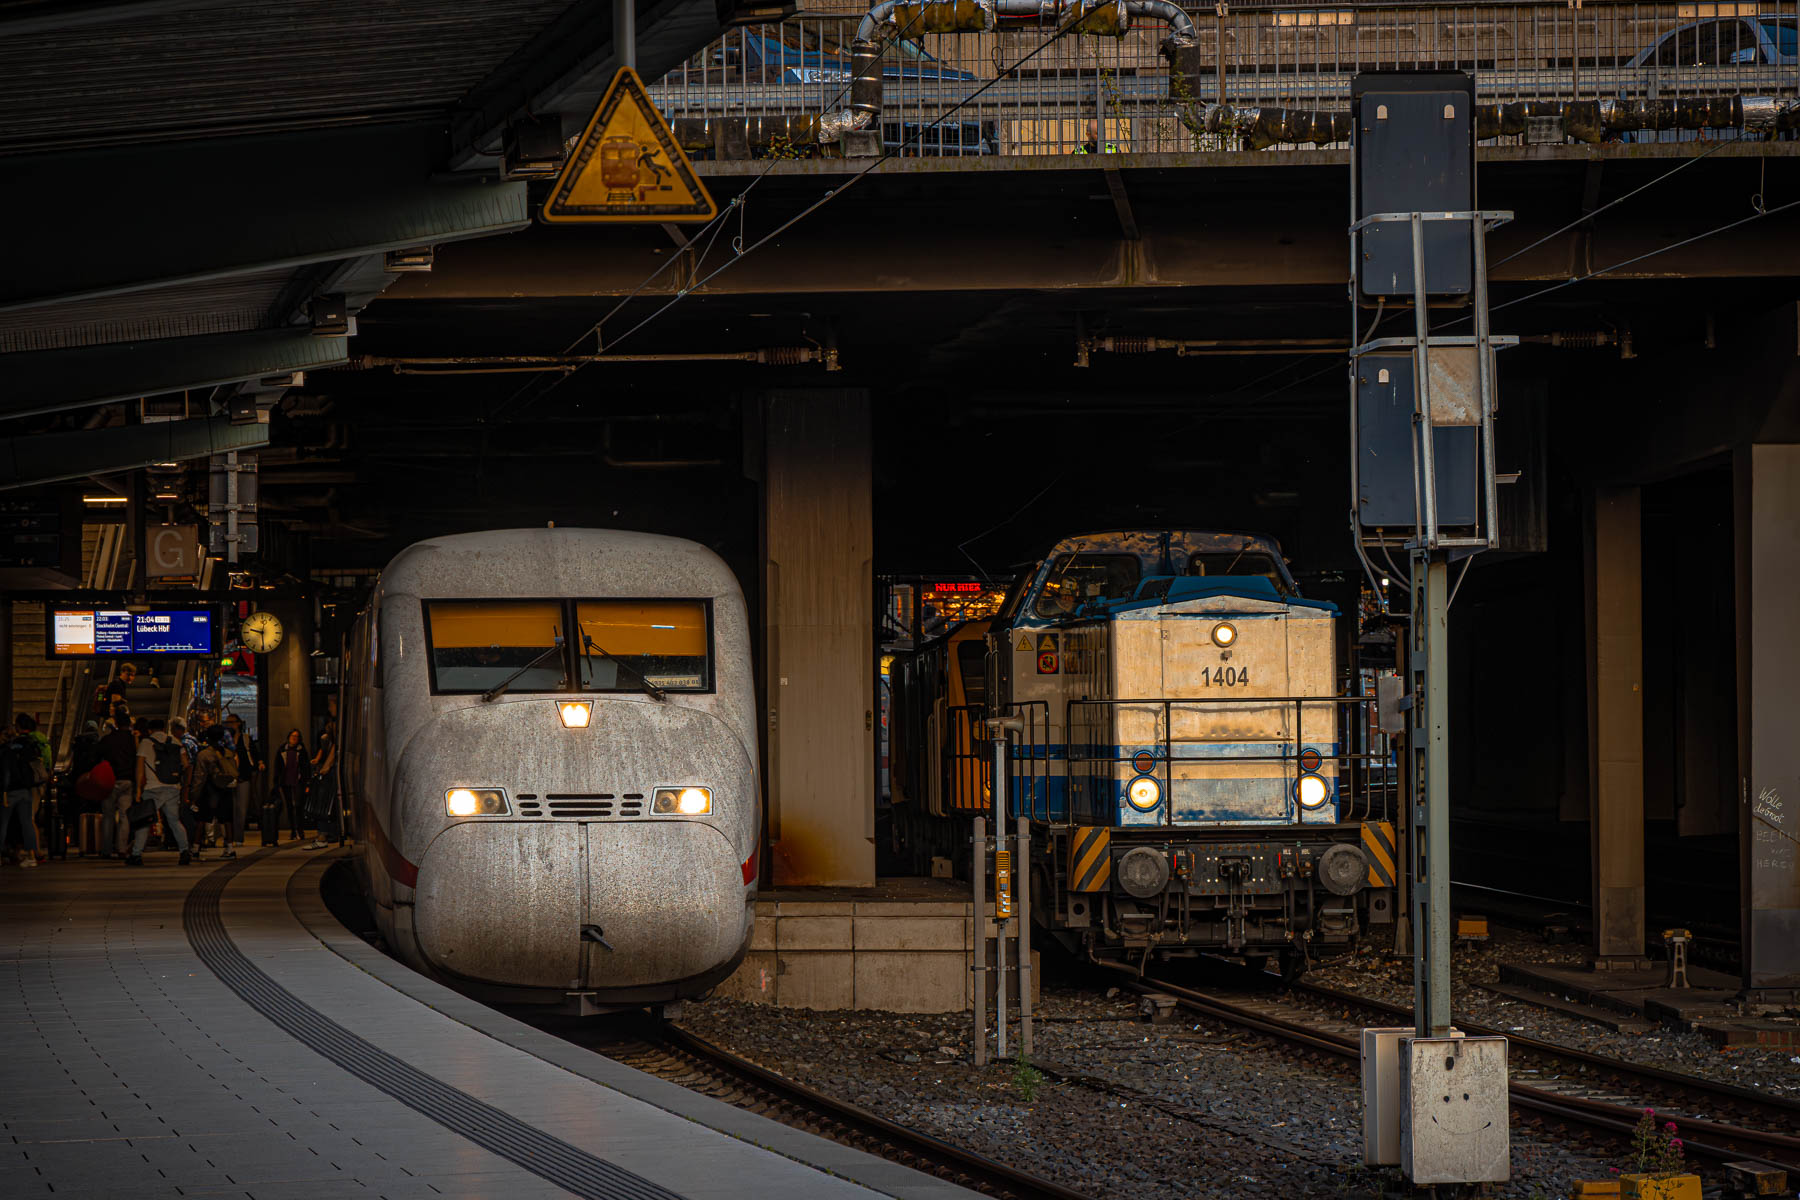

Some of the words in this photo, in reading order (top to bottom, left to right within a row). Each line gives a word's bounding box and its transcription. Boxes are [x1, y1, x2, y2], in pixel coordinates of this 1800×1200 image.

[154, 529, 184, 568] G
[935, 583, 956, 591] NUR
[957, 583, 981, 591] HIER
[137, 624, 158, 632] Lübeck
[158, 624, 170, 632] Hbf
[1201, 666, 1249, 687] 1404
